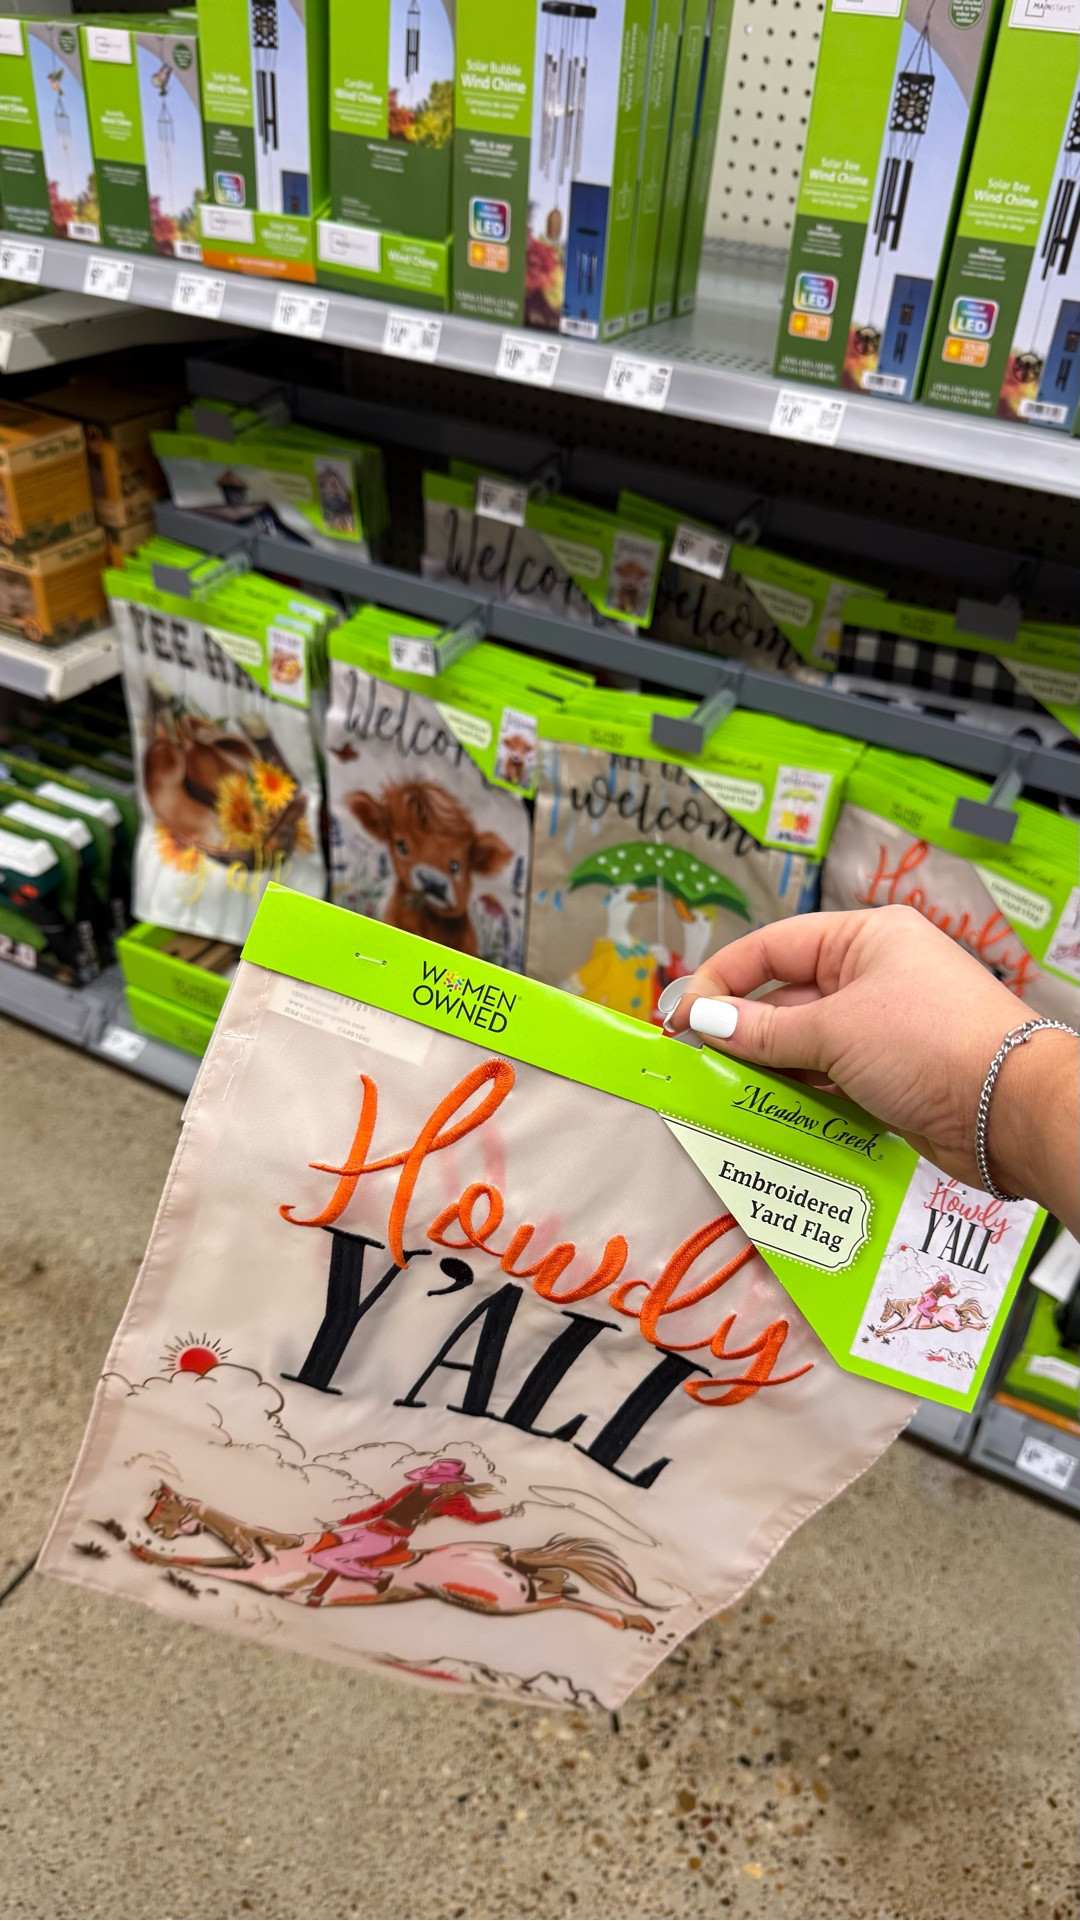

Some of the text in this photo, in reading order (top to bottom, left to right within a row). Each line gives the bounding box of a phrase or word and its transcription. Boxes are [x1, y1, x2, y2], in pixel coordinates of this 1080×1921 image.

[461, 74, 527, 95] Wind Chime
[466, 59, 522, 76] Solar Bubble
[335, 88, 383, 104] Wind Chime
[809, 169, 869, 187] Wind Chime
[821, 158, 860, 171] Solar Bee
[974, 189, 1039, 208] Wind Chime
[988, 178, 1031, 193] Solar Bee
[475, 219, 505, 236] LED
[800, 292, 829, 308] LED
[957, 317, 987, 333] LED
[129, 602, 195, 669] YEE
[423, 960, 517, 1013] WOMEN
[412, 984, 508, 1034] OWNED
[731, 1085, 881, 1162] Meadow Creek
[718, 1160, 854, 1225] Embroidered
[749, 1199, 845, 1254] Yard Flag
[923, 1177, 1013, 1245] Howdy
[279, 1058, 813, 1407] Howdy
[918, 1207, 996, 1275] Y'ALL
[280, 1225, 713, 1489] Y'ALL
